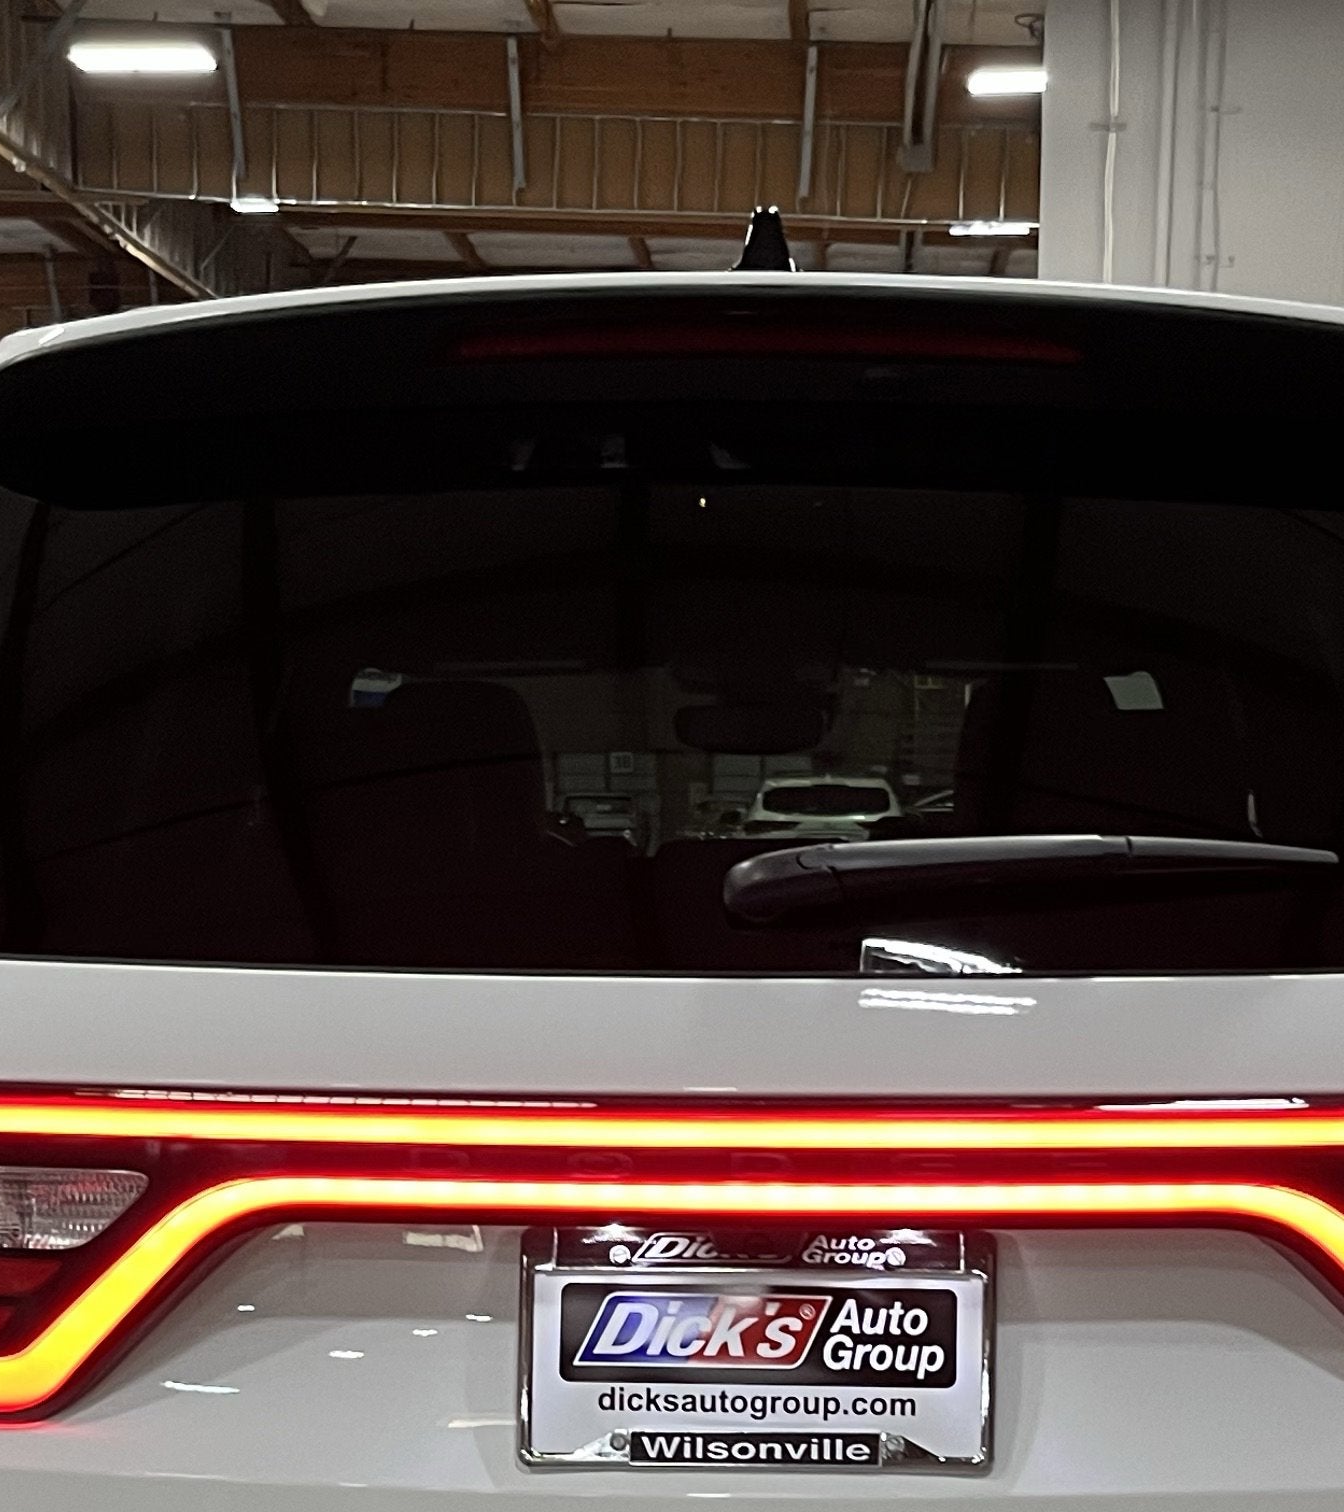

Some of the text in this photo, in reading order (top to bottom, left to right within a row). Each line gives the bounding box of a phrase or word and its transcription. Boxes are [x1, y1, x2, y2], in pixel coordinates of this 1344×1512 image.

[813, 1234, 876, 1250] Auto
[802, 1249, 887, 1270] Group
[593, 1299, 928, 1360] Dick's Auto
[823, 1333, 945, 1379] Group
[598, 1387, 916, 1420] dicksautogroup.com
[641, 1434, 872, 1461] Wilsonville
